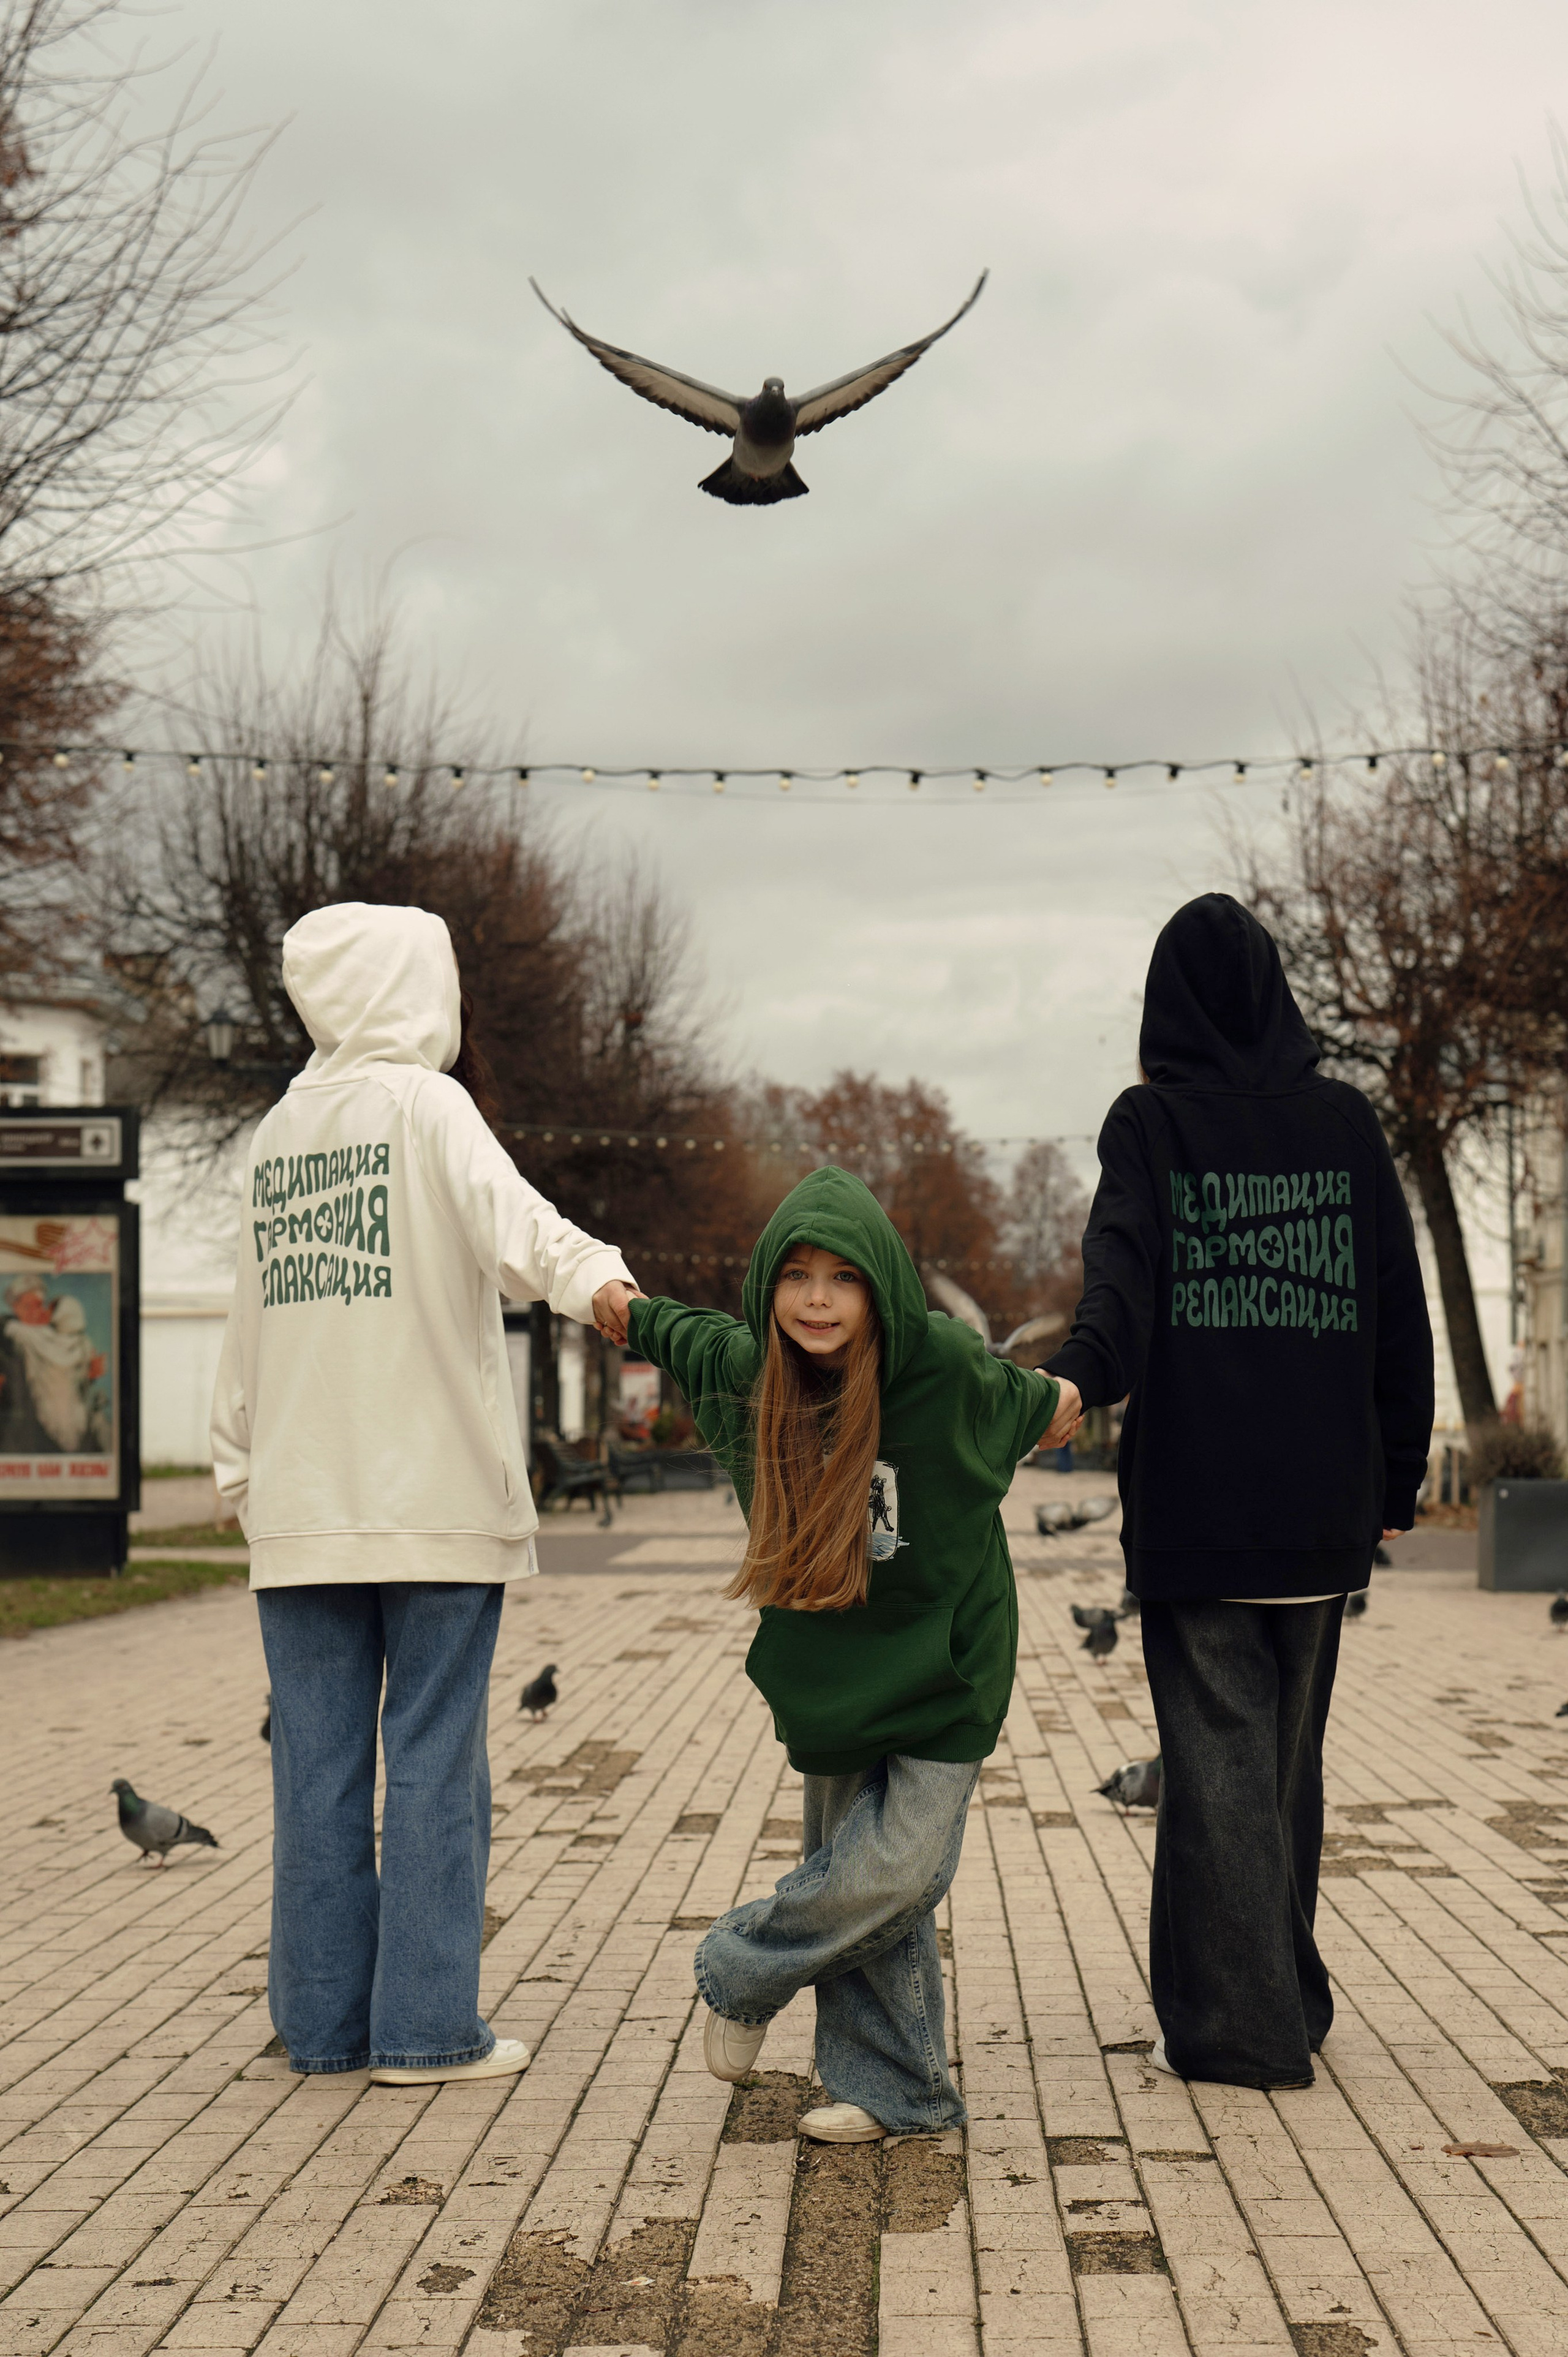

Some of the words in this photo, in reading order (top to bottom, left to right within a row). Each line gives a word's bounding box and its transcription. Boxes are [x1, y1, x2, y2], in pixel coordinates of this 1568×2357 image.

[252, 1143, 390, 1215] МЕДИТАЦИЯ
[1170, 1170, 1351, 1234] МЕДИТАЦИЯ
[254, 1185, 390, 1262] ГАРМОНИЯ
[1172, 1213, 1356, 1289] ГАРМОНИЯ
[262, 1252, 391, 1308] ЛАКСАЦИЯ
[1170, 1275, 1358, 1338] РЕЛАКСАЦИЯ
